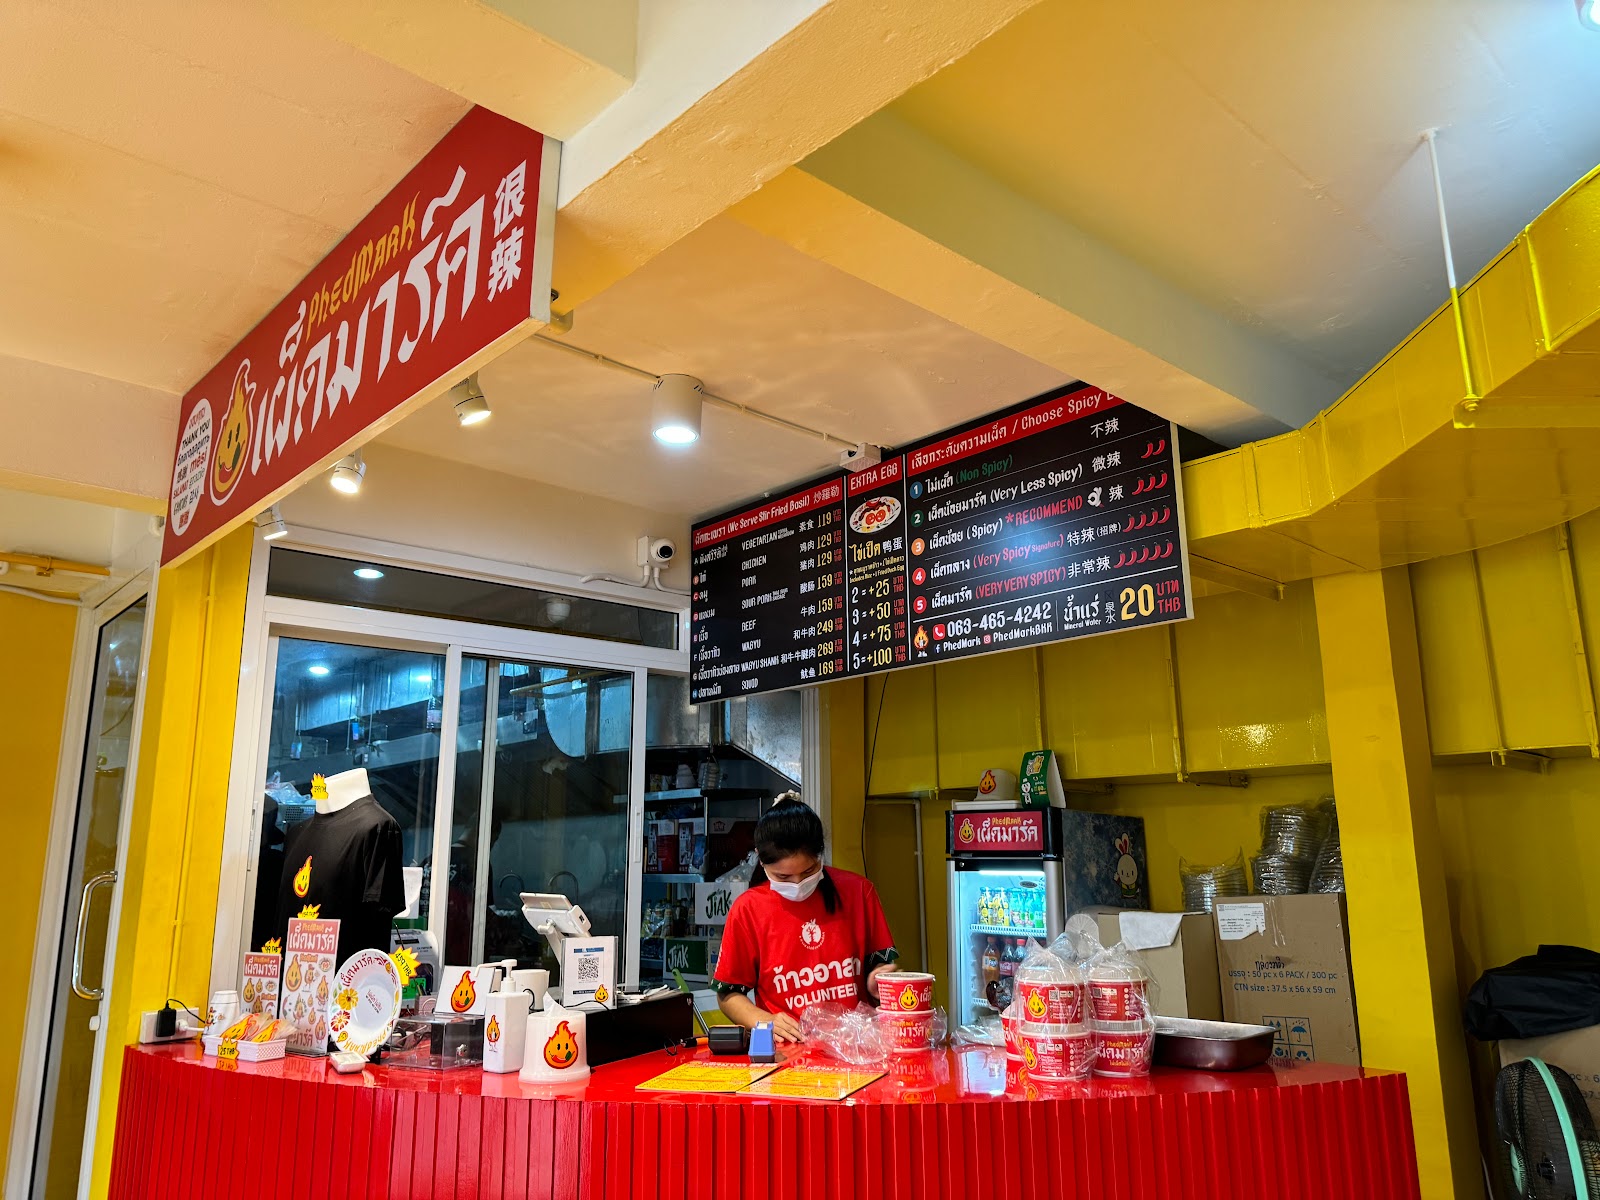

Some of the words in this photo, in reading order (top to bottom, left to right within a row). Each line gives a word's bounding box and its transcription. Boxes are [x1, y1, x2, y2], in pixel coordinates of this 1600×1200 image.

[487, 159, 527, 302] 很辣
[182, 428, 199, 450] THANK
[911, 422, 1007, 469] เลือกระดับความเผ็ด
[1012, 419, 1018, 434] /
[1021, 406, 1063, 430] Choose
[1067, 393, 1101, 414] Spicy
[925, 471, 953, 493] ไม่เผ็ด
[956, 469, 979, 484] (Non
[982, 454, 1013, 477] Spicy)
[1090, 417, 1119, 438] 不辣
[850, 469, 878, 490] EXTRA
[880, 462, 898, 480] EGG
[928, 491, 987, 521] เผ็ดน้อยมาร์ค
[990, 485, 1018, 504] (Very
[1020, 477, 1046, 494] Less
[1047, 463, 1083, 487] Spicy)
[1092, 450, 1121, 473] 微辣
[739, 515, 758, 529] Serve
[770, 503, 789, 518] Fried
[742, 530, 778, 551] VEGETARIAN
[817, 511, 832, 528] 119
[929, 529, 963, 550] เผ็ดน้อย
[966, 518, 1003, 540] (Spicy)
[1108, 484, 1124, 502] 辣
[742, 554, 767, 571] CHICKEN
[817, 532, 832, 549] 129
[930, 561, 970, 579] เผ็ดกลาง
[973, 552, 1001, 569] (Very
[1002, 544, 1031, 562] Spicy
[1067, 526, 1095, 547] 特辣
[742, 574, 757, 588] PORK
[817, 550, 832, 567] 129
[931, 586, 972, 609] เผ็ดมาร์ค
[975, 580, 1003, 599] (VERY
[1003, 574, 1029, 593] VERY
[1029, 566, 1066, 588] SPICY)
[1067, 554, 1111, 578] 非常辣
[742, 597, 756, 609] SOUR
[757, 593, 772, 605] PORK
[817, 573, 833, 590] 159
[852, 586, 859, 604] 2
[1119, 583, 1155, 621] 20
[1156, 579, 1179, 596] บาท
[742, 619, 756, 632] BEEF
[800, 604, 816, 618] 牛肉
[817, 597, 833, 613] 159
[852, 608, 859, 625] 3
[946, 601, 1052, 638] 063-465-4242
[1063, 593, 1100, 622] น้ำแร่
[1157, 596, 1181, 614] THB
[742, 639, 761, 652] WAGYU
[793, 626, 816, 640] 和牛肉
[817, 619, 833, 635] 249
[993, 621, 1053, 643] PhedMarkBKK
[1063, 615, 1084, 631] Mineral
[852, 630, 860, 647] 4
[943, 635, 981, 652] PhedMark
[741, 659, 759, 672] WAGYU
[817, 641, 833, 657] 269
[853, 653, 860, 669] 5
[742, 677, 758, 690] SQUID
[818, 660, 833, 676] 169
[977, 817, 1038, 842] เผ็ดมาร์ค
[289, 923, 335, 951] เผ็ดมาร์ค
[773, 956, 861, 994] ก้าวอาสา
[1228, 971, 1246, 979] บรรจุ
[1234, 983, 1249, 991] CTN
